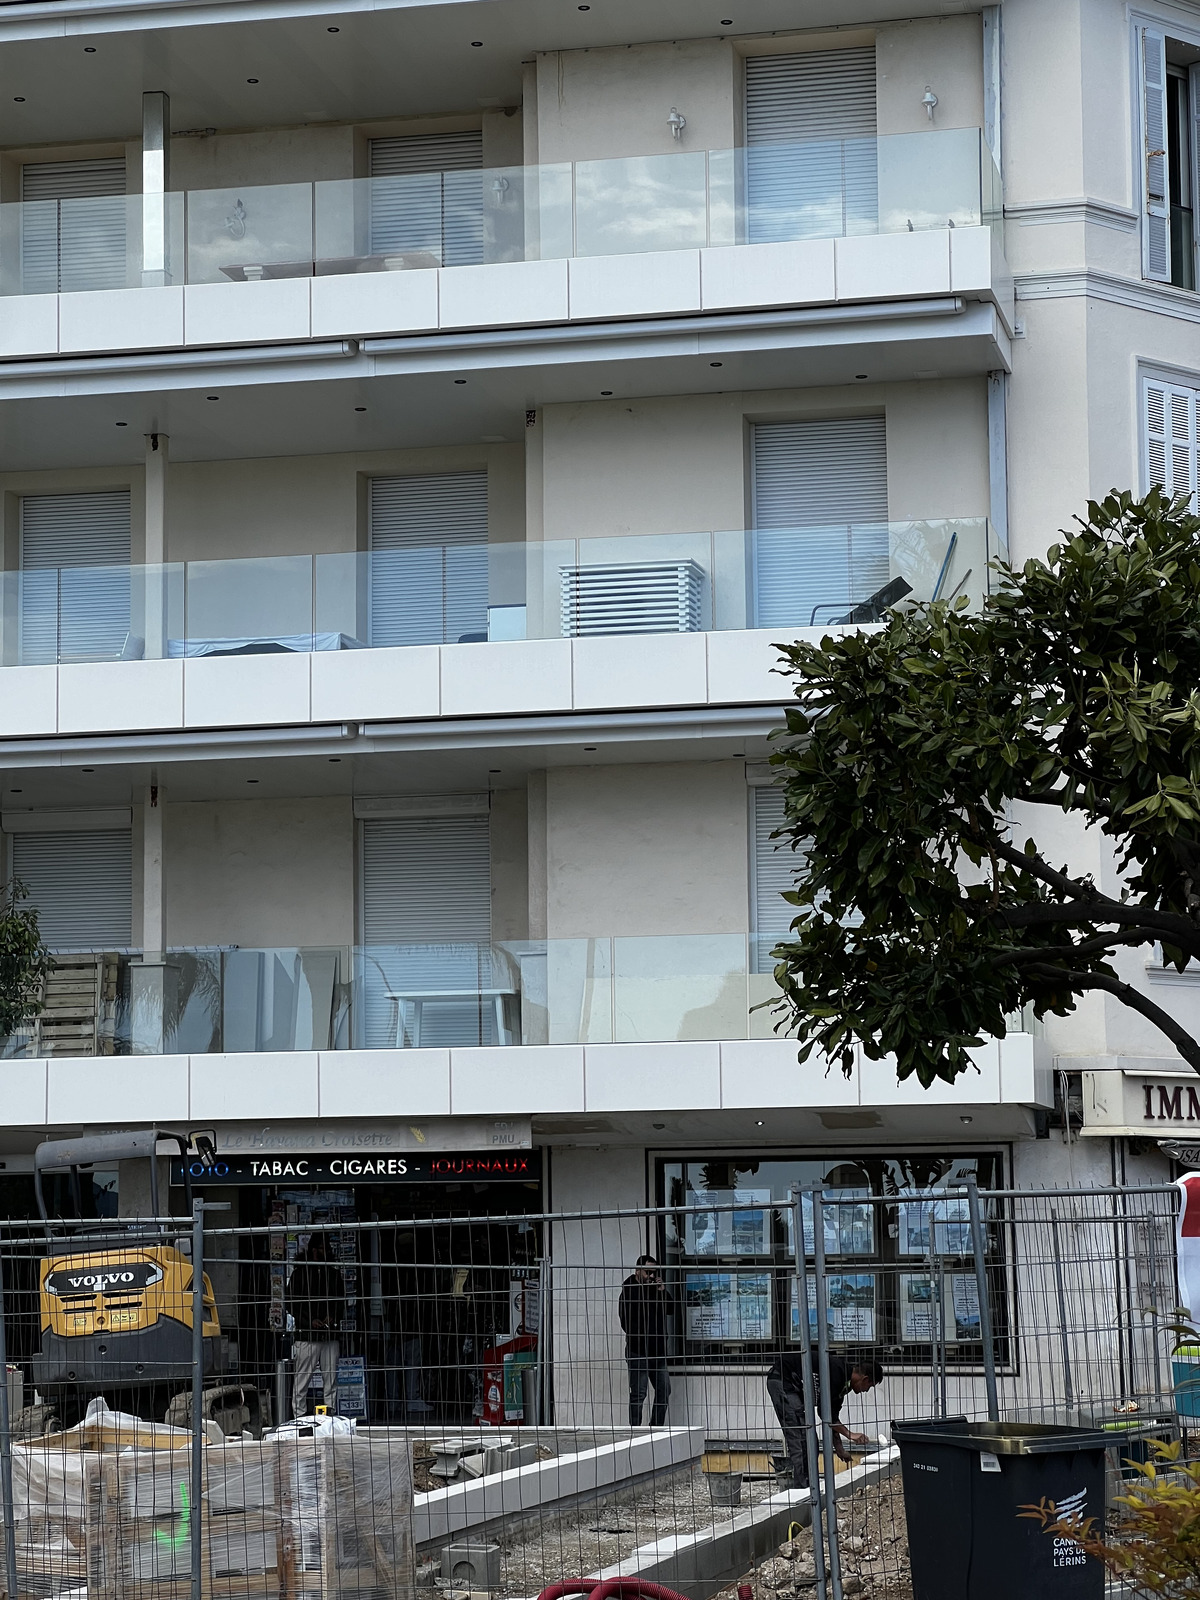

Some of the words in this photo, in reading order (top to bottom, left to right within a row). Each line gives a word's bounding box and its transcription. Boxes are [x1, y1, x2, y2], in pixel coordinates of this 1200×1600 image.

[222, 1133, 243, 1148] Le
[322, 1130, 392, 1146] Croisette
[492, 1133, 515, 1144] PMU
[250, 1160, 309, 1176] TABAC
[329, 1159, 408, 1175] CIGARES
[429, 1157, 529, 1174] JOURNAUX
[68, 1271, 135, 1288] VOLVO
[1053, 1538, 1085, 1547] CANN
[1053, 1547, 1074, 1556] PAYS
[1053, 1555, 1087, 1567] LÉRINS
